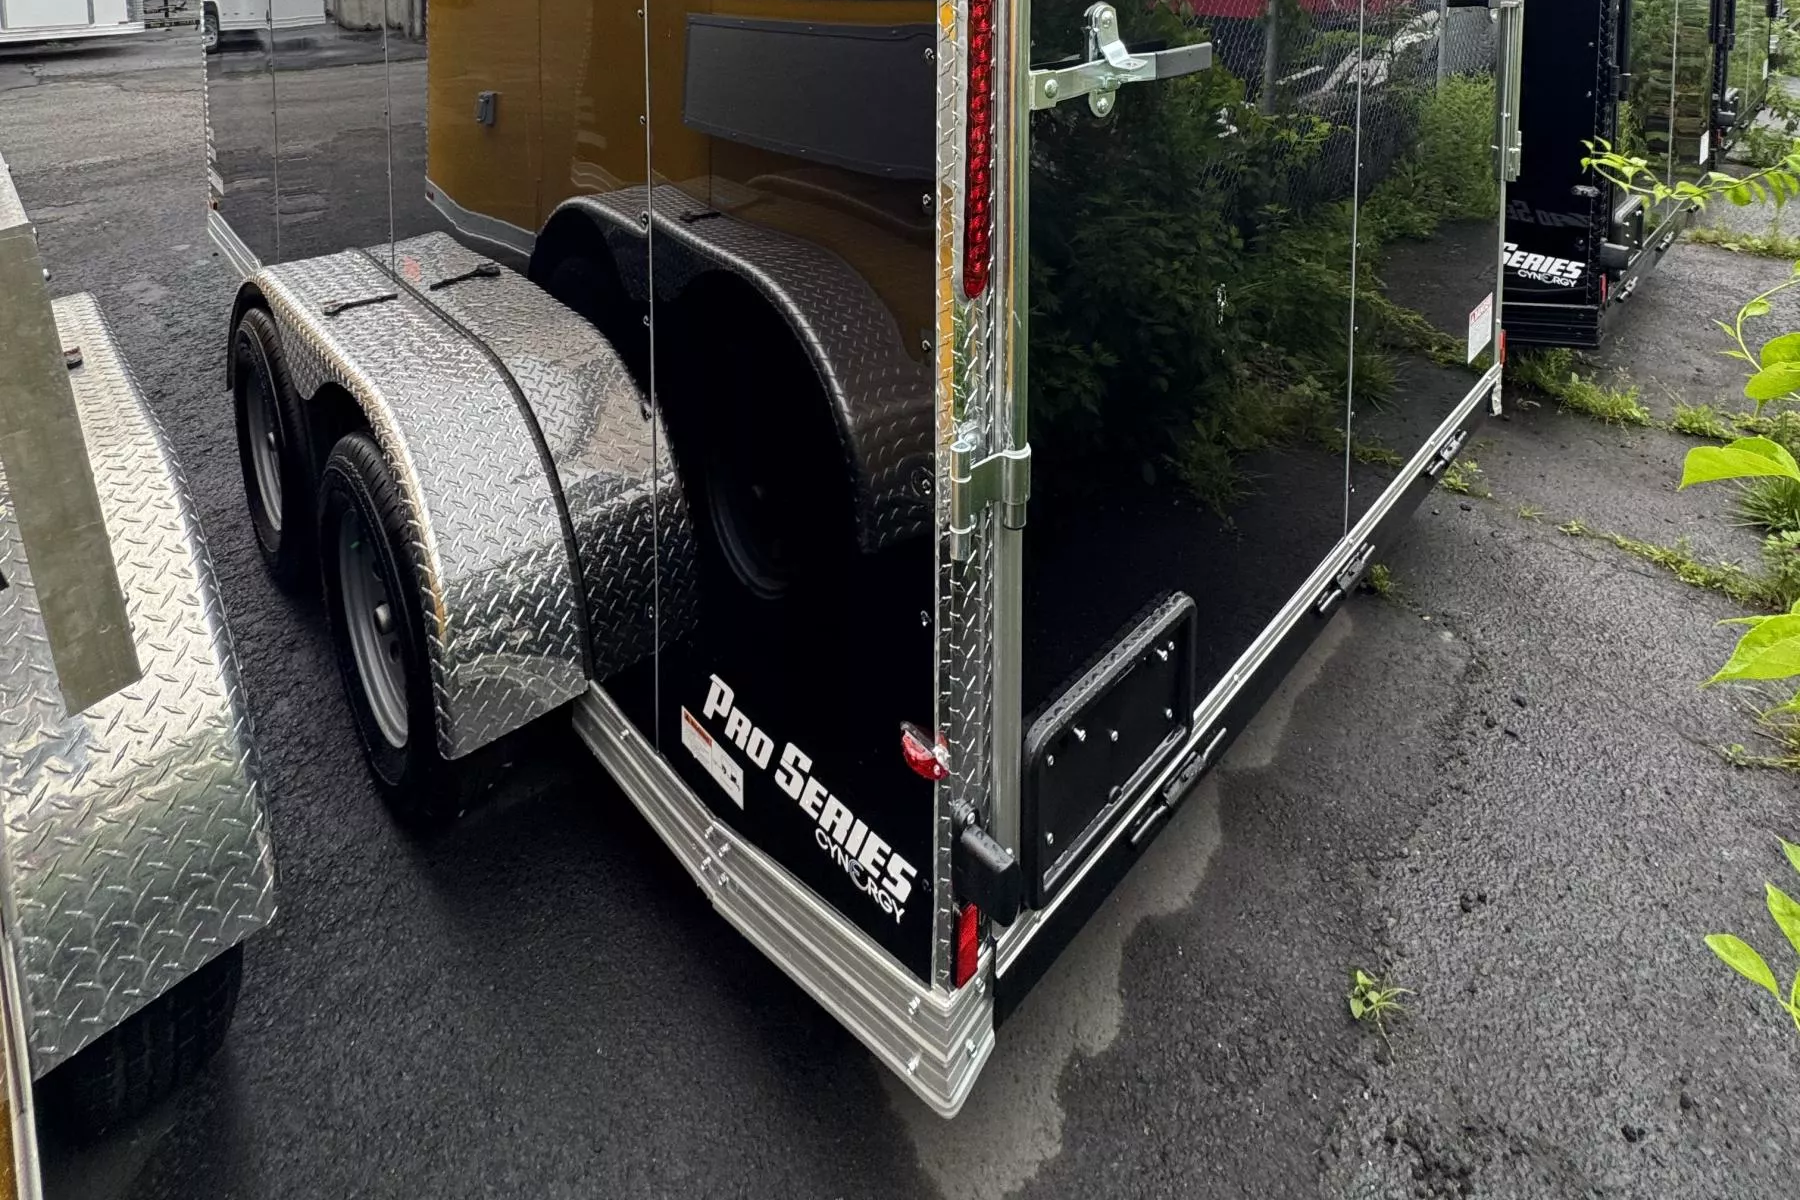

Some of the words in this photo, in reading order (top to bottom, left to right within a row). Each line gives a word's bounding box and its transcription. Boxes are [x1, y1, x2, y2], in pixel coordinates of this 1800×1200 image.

[1517, 269, 1577, 287] CYNERGY
[702, 673, 775, 770] PRO
[774, 741, 918, 904] SERIES
[814, 828, 906, 924] CYNERGY
